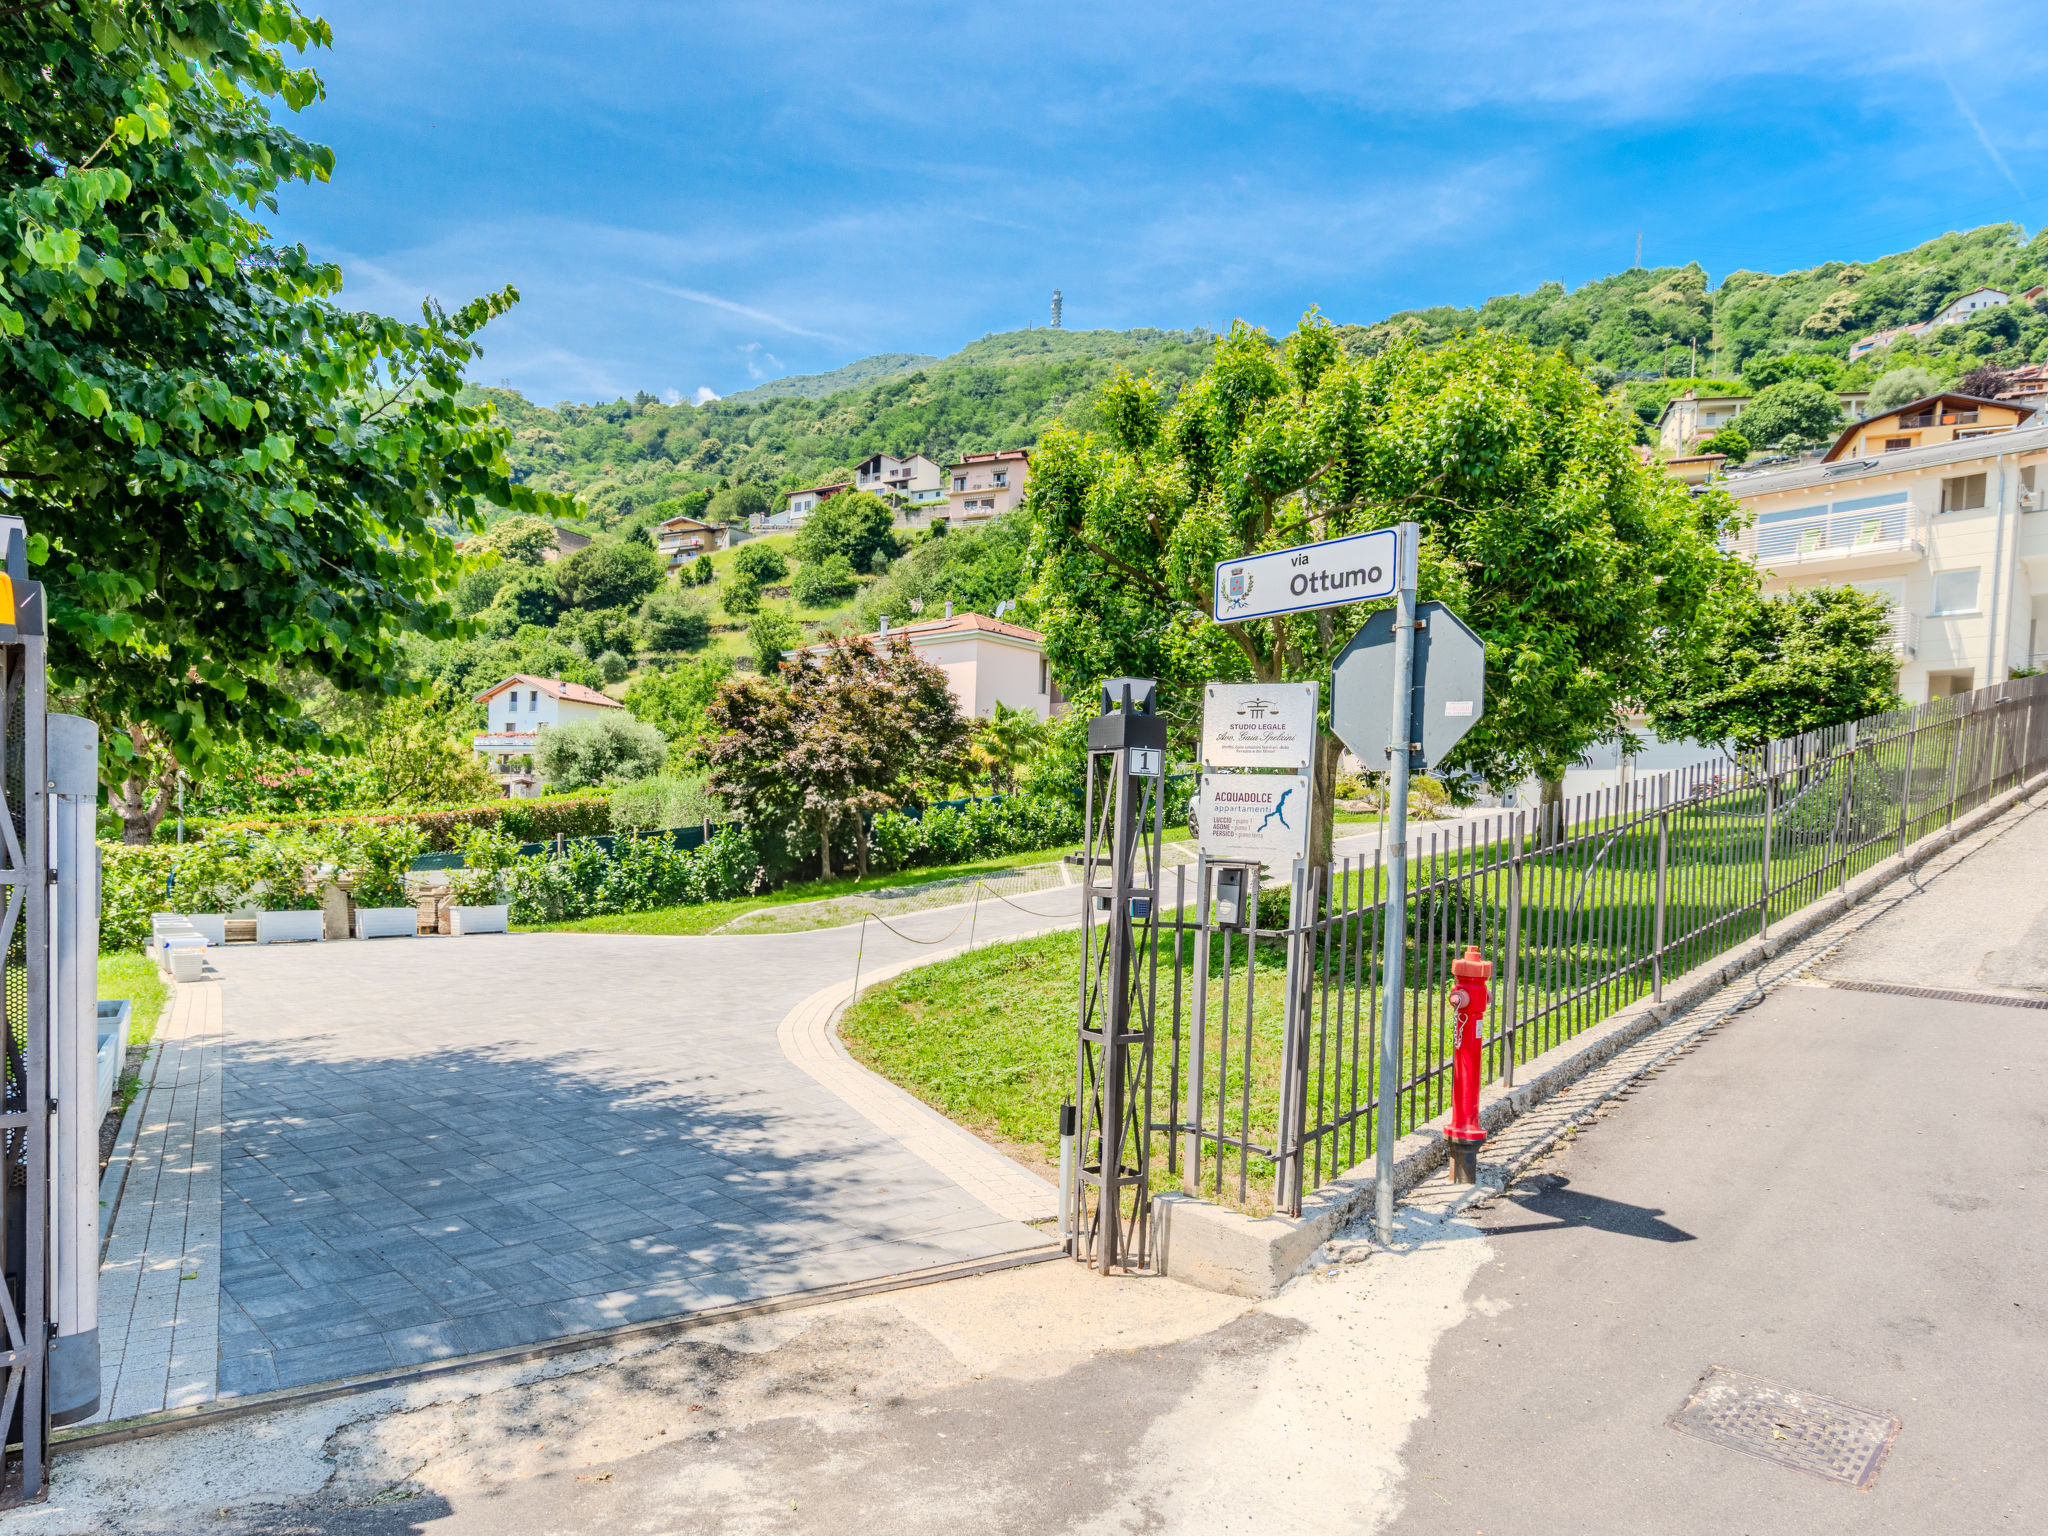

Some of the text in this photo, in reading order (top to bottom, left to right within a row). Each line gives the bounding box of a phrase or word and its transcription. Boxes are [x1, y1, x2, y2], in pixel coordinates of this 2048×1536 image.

[1291, 553, 1309, 567] via
[1290, 566, 1383, 596] Ottumo
[1258, 723, 1286, 731] LEGALE
[1238, 731, 1258, 742] Gaia
[1141, 752, 1149, 769] 1
[1214, 791, 1273, 803] ACQUADOLCE
[1214, 805, 1272, 814] appartamenti
